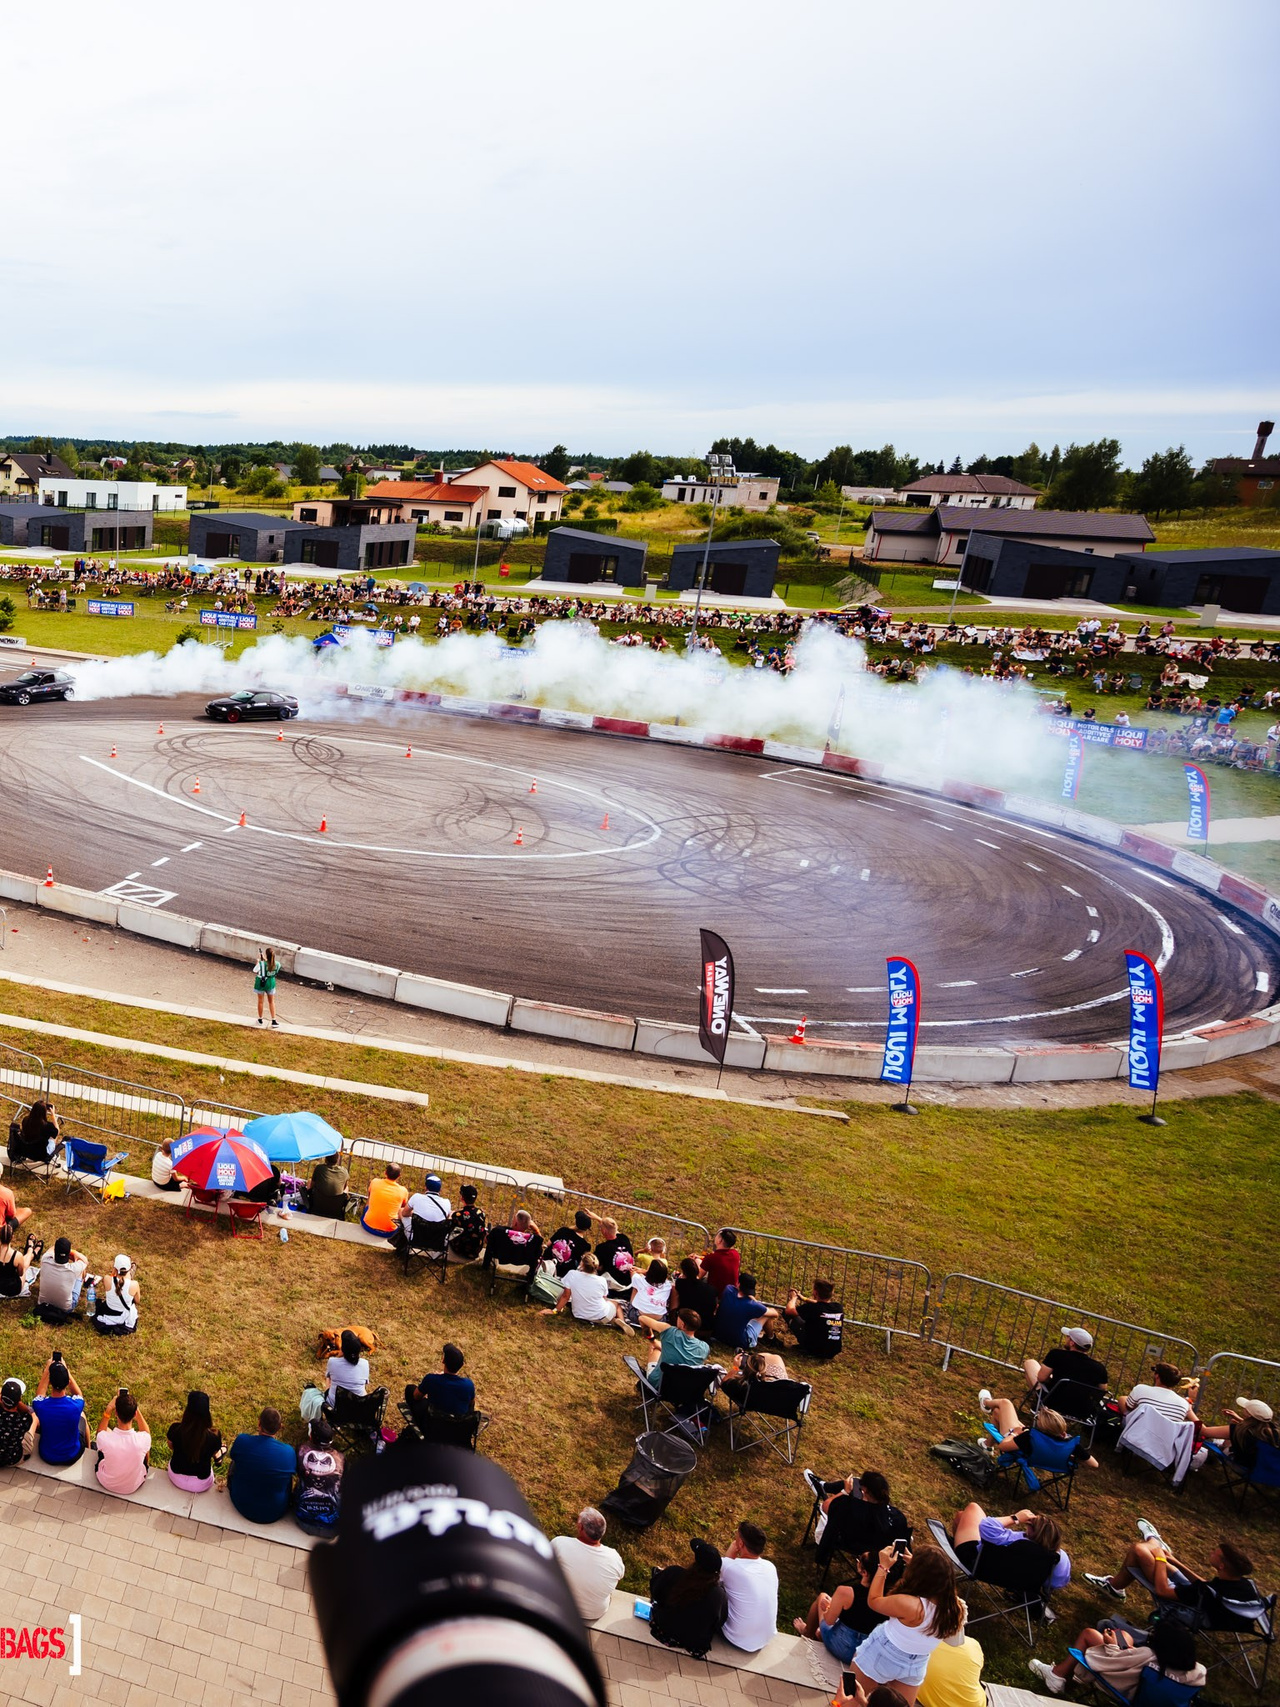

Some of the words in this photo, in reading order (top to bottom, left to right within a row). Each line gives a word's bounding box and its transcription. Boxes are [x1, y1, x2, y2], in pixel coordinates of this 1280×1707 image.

[1077, 723, 1099, 731] MOTOR
[1099, 726, 1114, 734] OILS
[1078, 729, 1111, 738] ADDITIVES
[1116, 729, 1143, 739] LIQUI
[1091, 736, 1109, 744] CARE
[1114, 737, 1142, 748] MOLY
